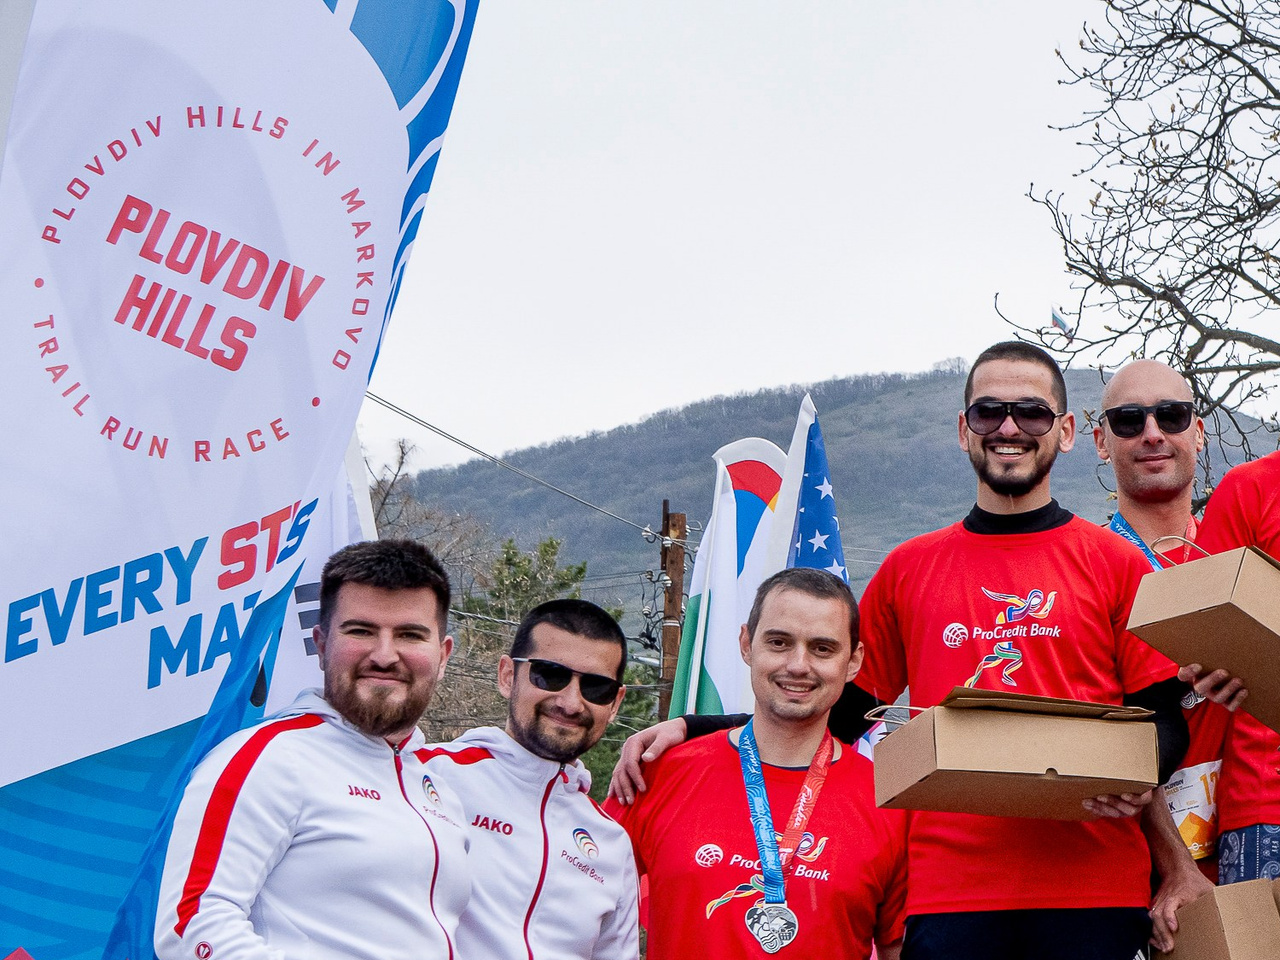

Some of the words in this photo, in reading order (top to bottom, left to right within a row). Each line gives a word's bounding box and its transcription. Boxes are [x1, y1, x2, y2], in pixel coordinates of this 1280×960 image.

[41, 115, 162, 244] PLOVDIV
[186, 105, 289, 140] HILLS
[302, 138, 341, 177] IN
[332, 187, 375, 371] MARKOVO
[105, 194, 326, 323] PLOVDIV
[113, 273, 257, 372] HILLS
[33, 314, 91, 417] TRAIL
[100, 415, 169, 460] RUN
[194, 417, 289, 463] RACE
[4, 535, 209, 664] EVERY
[972, 625, 1028, 640] ProCredit
[1030, 623, 1061, 638] Bank
[348, 784, 381, 801] JAKO
[471, 814, 513, 836] JAKO
[794, 864, 831, 881] Bank
